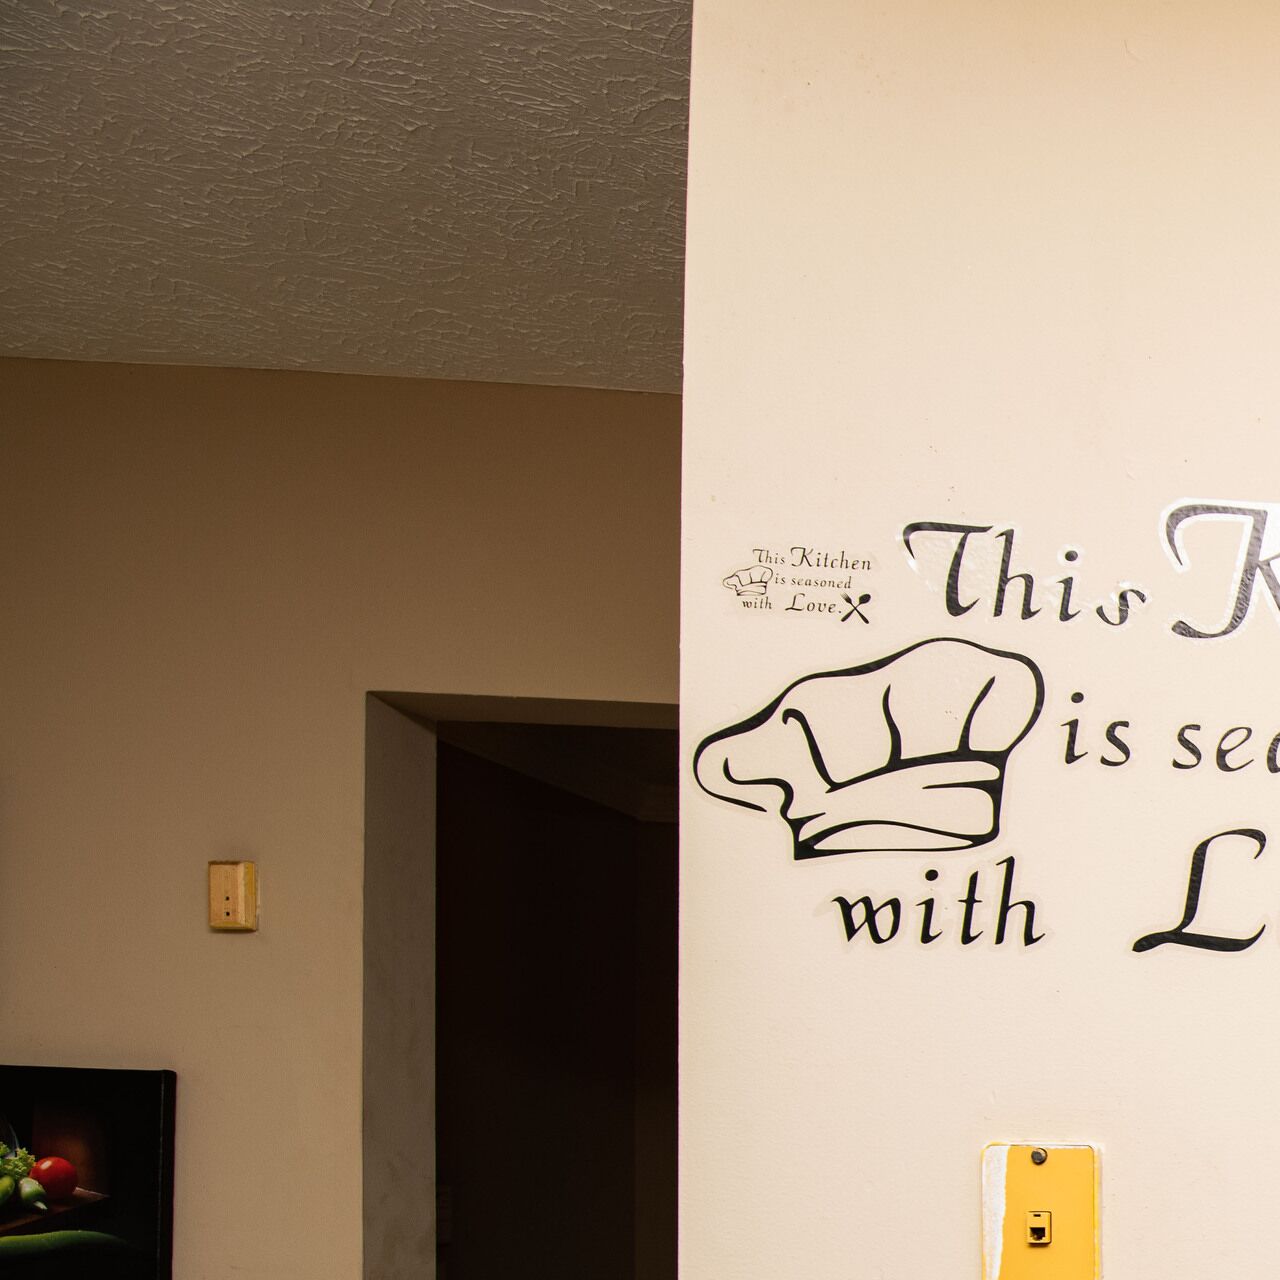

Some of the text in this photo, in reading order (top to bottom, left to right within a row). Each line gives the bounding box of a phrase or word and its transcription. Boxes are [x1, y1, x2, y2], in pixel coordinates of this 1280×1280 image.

[752, 546, 872, 571] This Kitchen
[774, 573, 852, 589] is seasoned
[903, 521, 1147, 626] This
[742, 592, 843, 614] with Love.
[1060, 692, 1131, 767] is
[832, 856, 1046, 947] with
